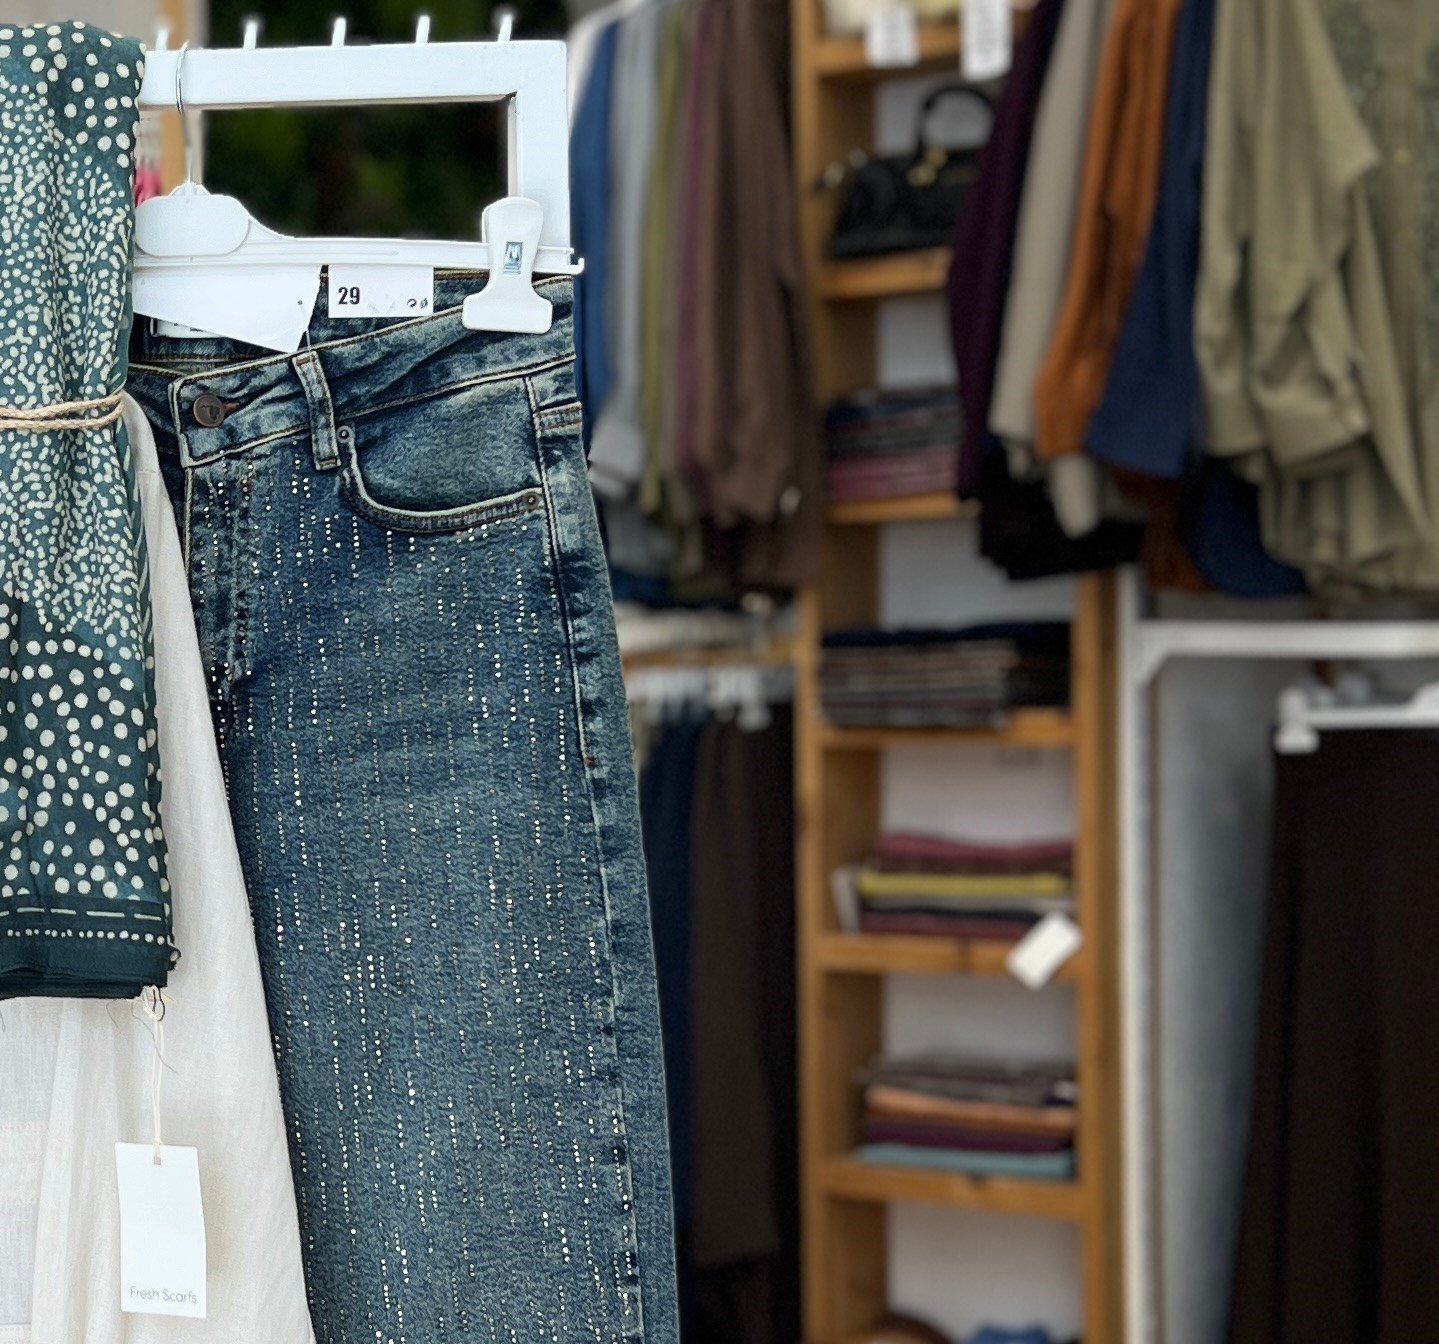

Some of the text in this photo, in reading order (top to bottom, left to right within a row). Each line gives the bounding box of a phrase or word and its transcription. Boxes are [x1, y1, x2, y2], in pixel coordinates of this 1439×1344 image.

[338, 286, 360, 305] 29
[130, 1285, 197, 1303] Fresh Scarfs
